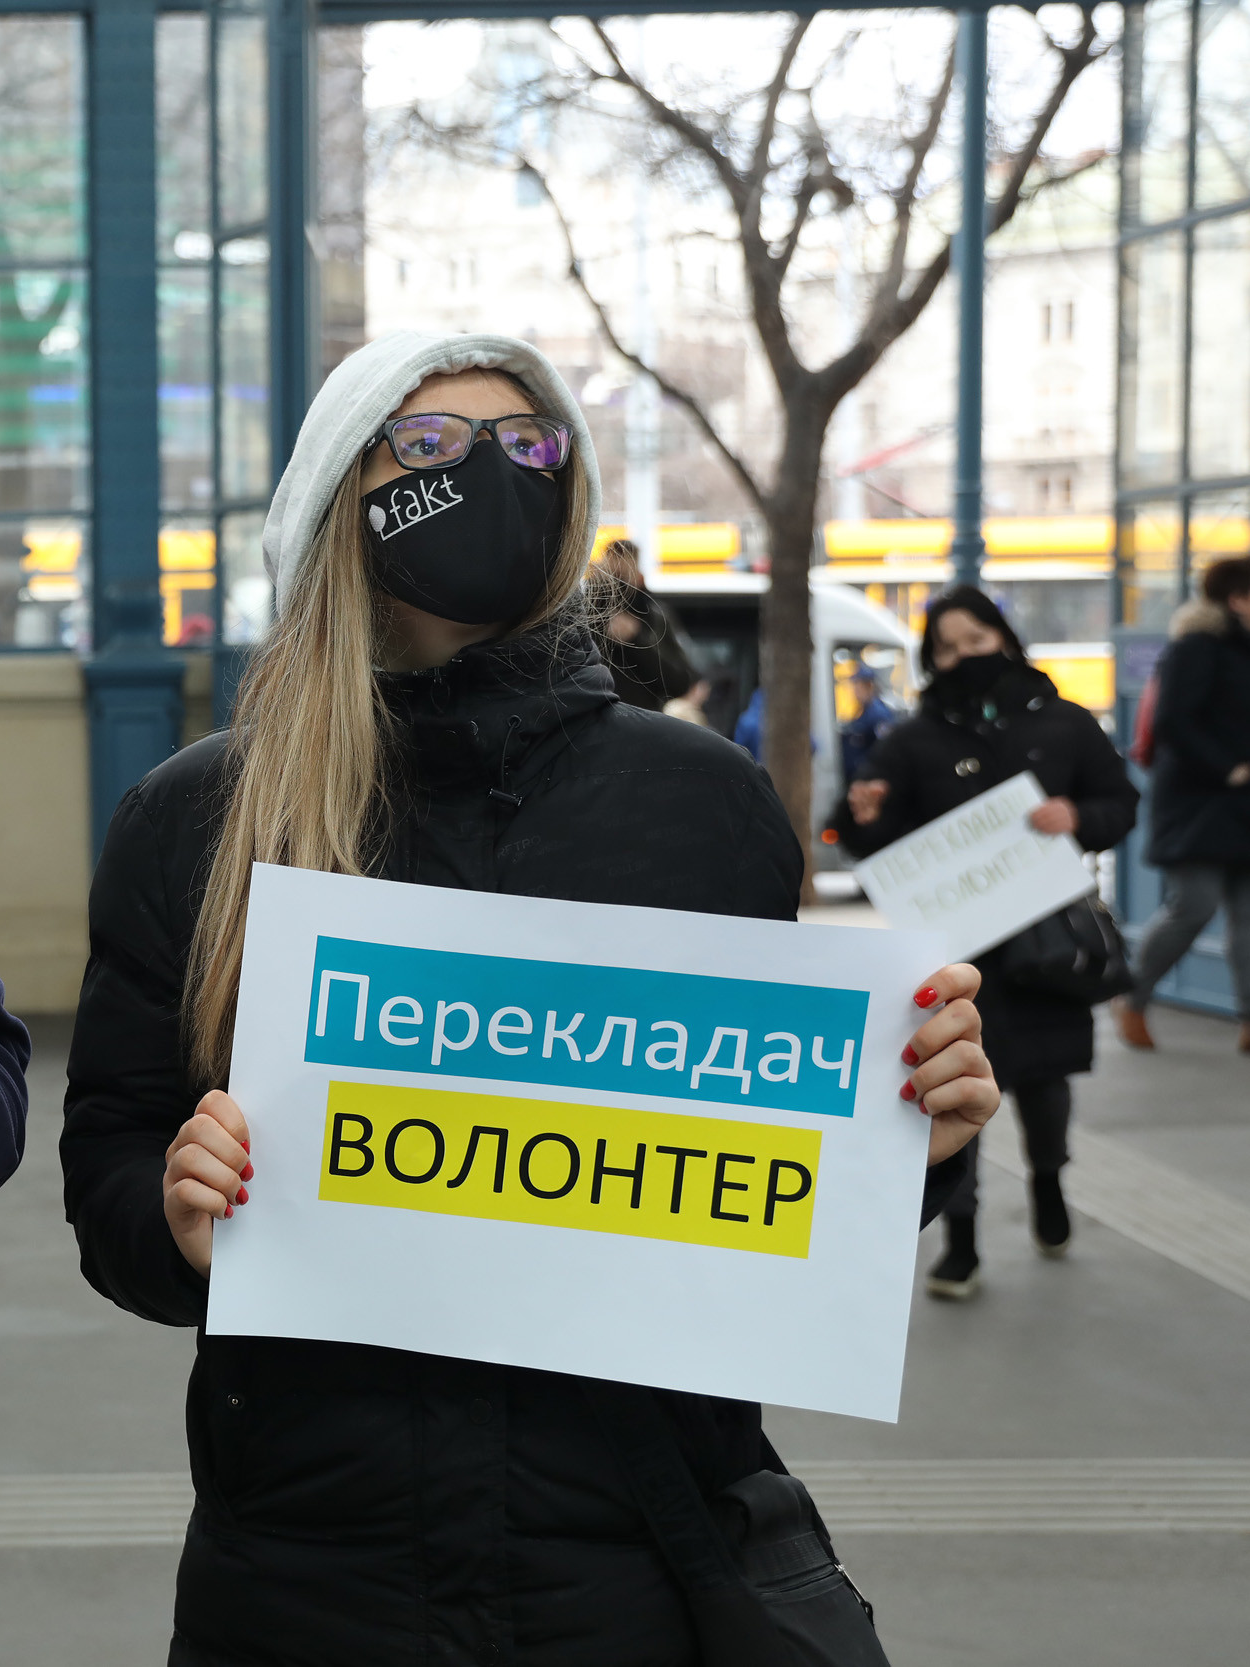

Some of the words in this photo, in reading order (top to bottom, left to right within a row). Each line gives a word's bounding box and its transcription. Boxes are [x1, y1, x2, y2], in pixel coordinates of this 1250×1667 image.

[389, 474, 463, 530] fakt
[314, 969, 856, 1095] Перекладач
[328, 1112, 812, 1226] ВОЛОНТЕР
